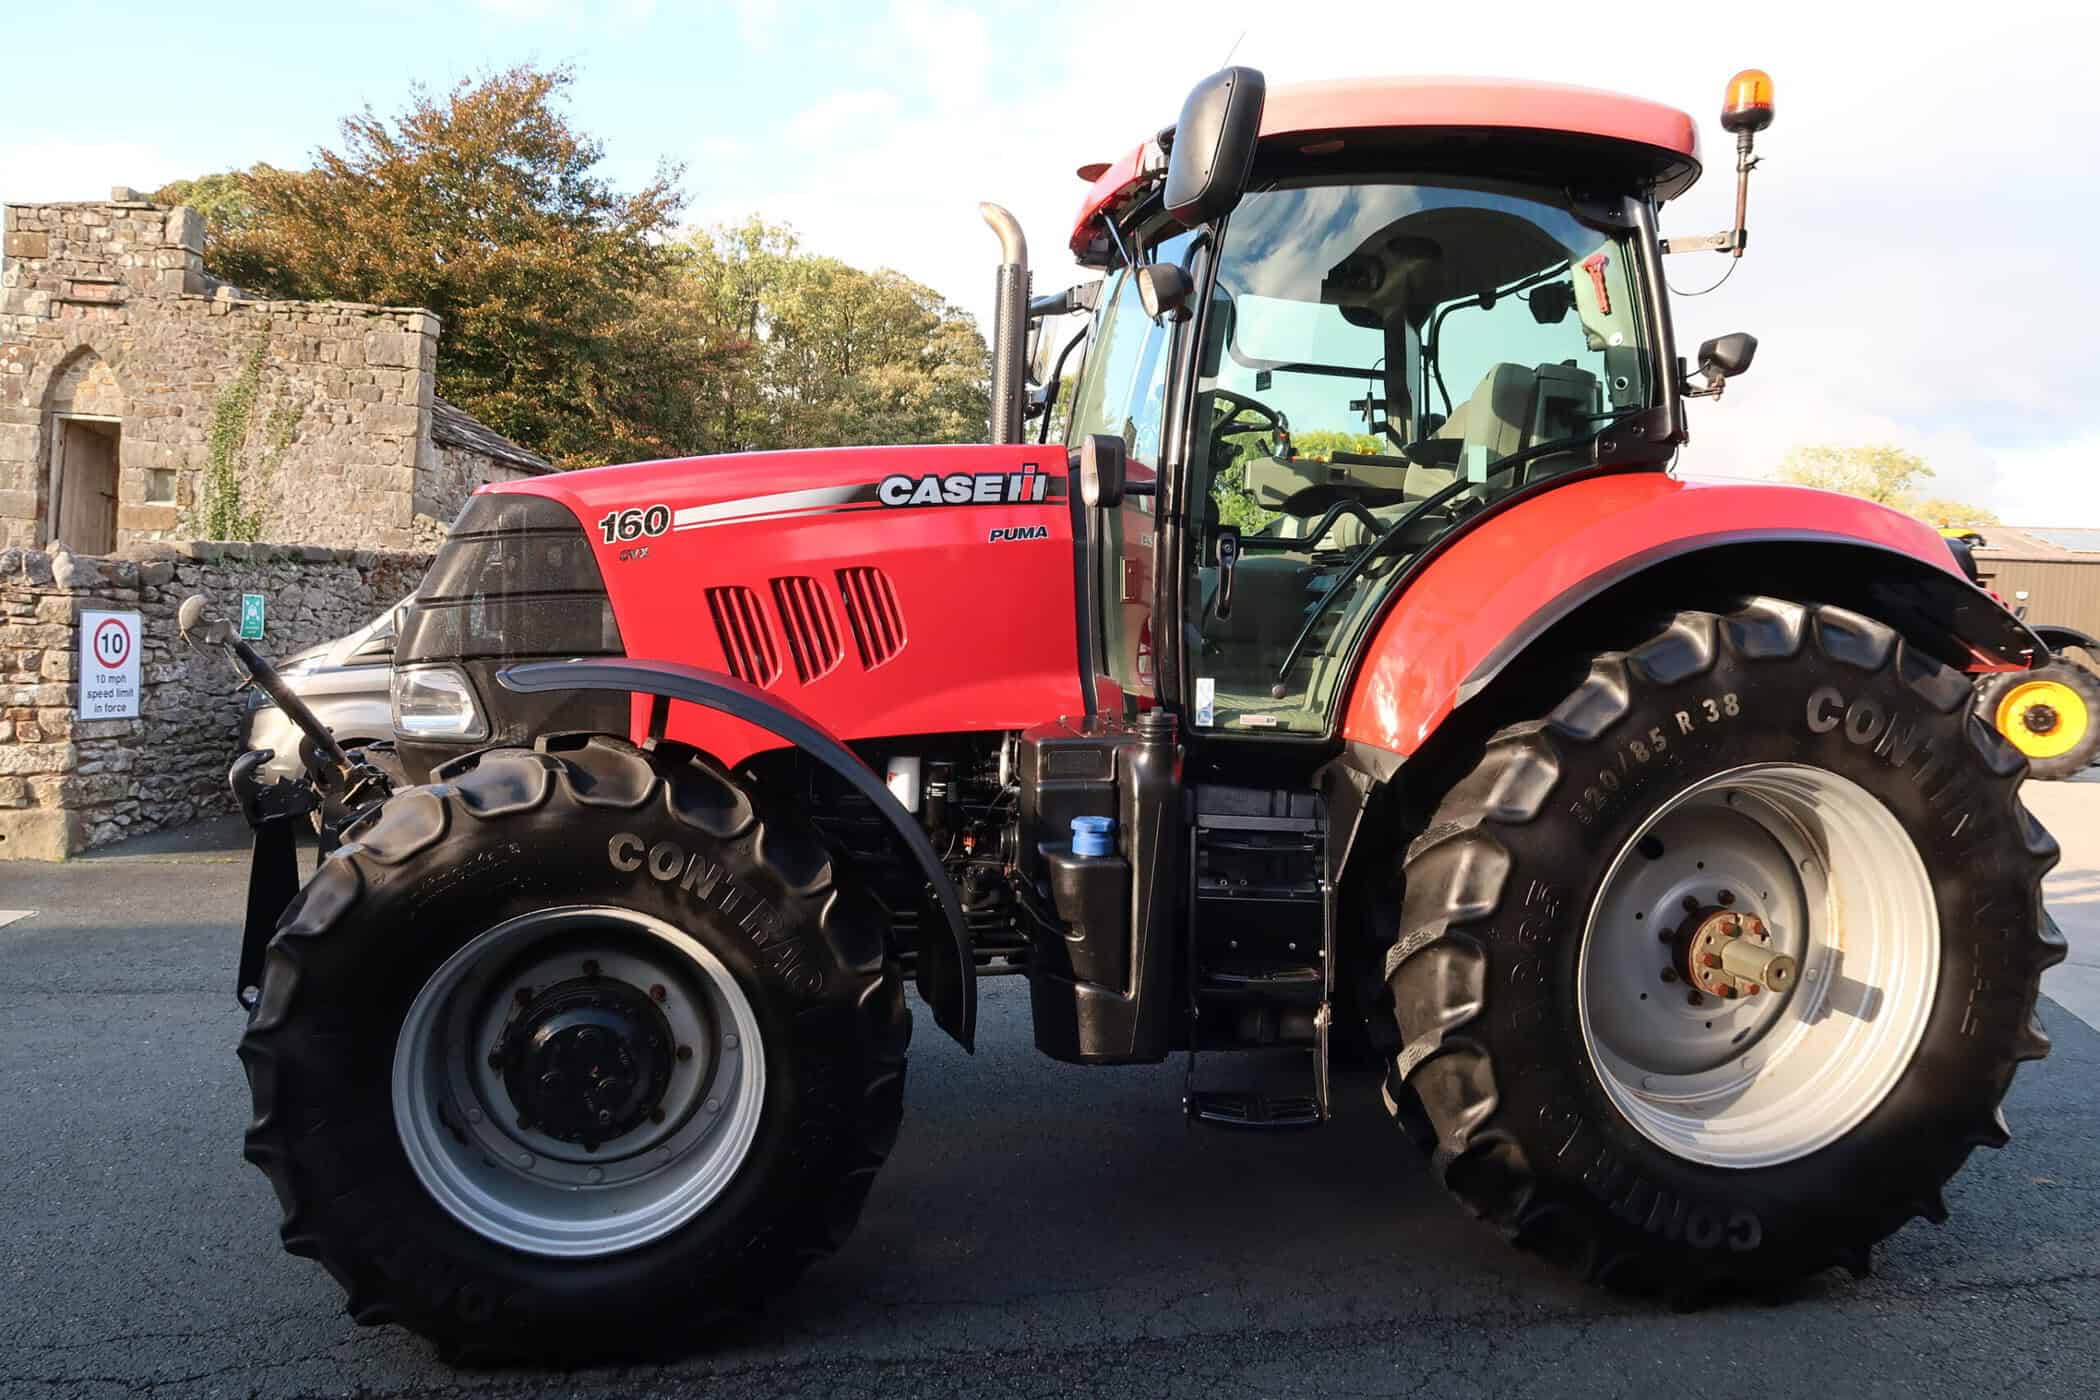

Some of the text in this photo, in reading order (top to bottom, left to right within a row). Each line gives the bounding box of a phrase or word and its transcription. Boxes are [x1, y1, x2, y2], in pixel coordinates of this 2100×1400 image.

[877, 474, 1004, 507] CASE
[599, 504, 672, 544] 160
[989, 526, 1048, 543] PUMA
[101, 633, 123, 654] 10
[96, 674, 127, 685] 10 mph
[87, 688, 134, 700] speed limit
[94, 703, 127, 713] in force
[1675, 709, 1697, 736] R
[1702, 692, 1742, 724] 38
